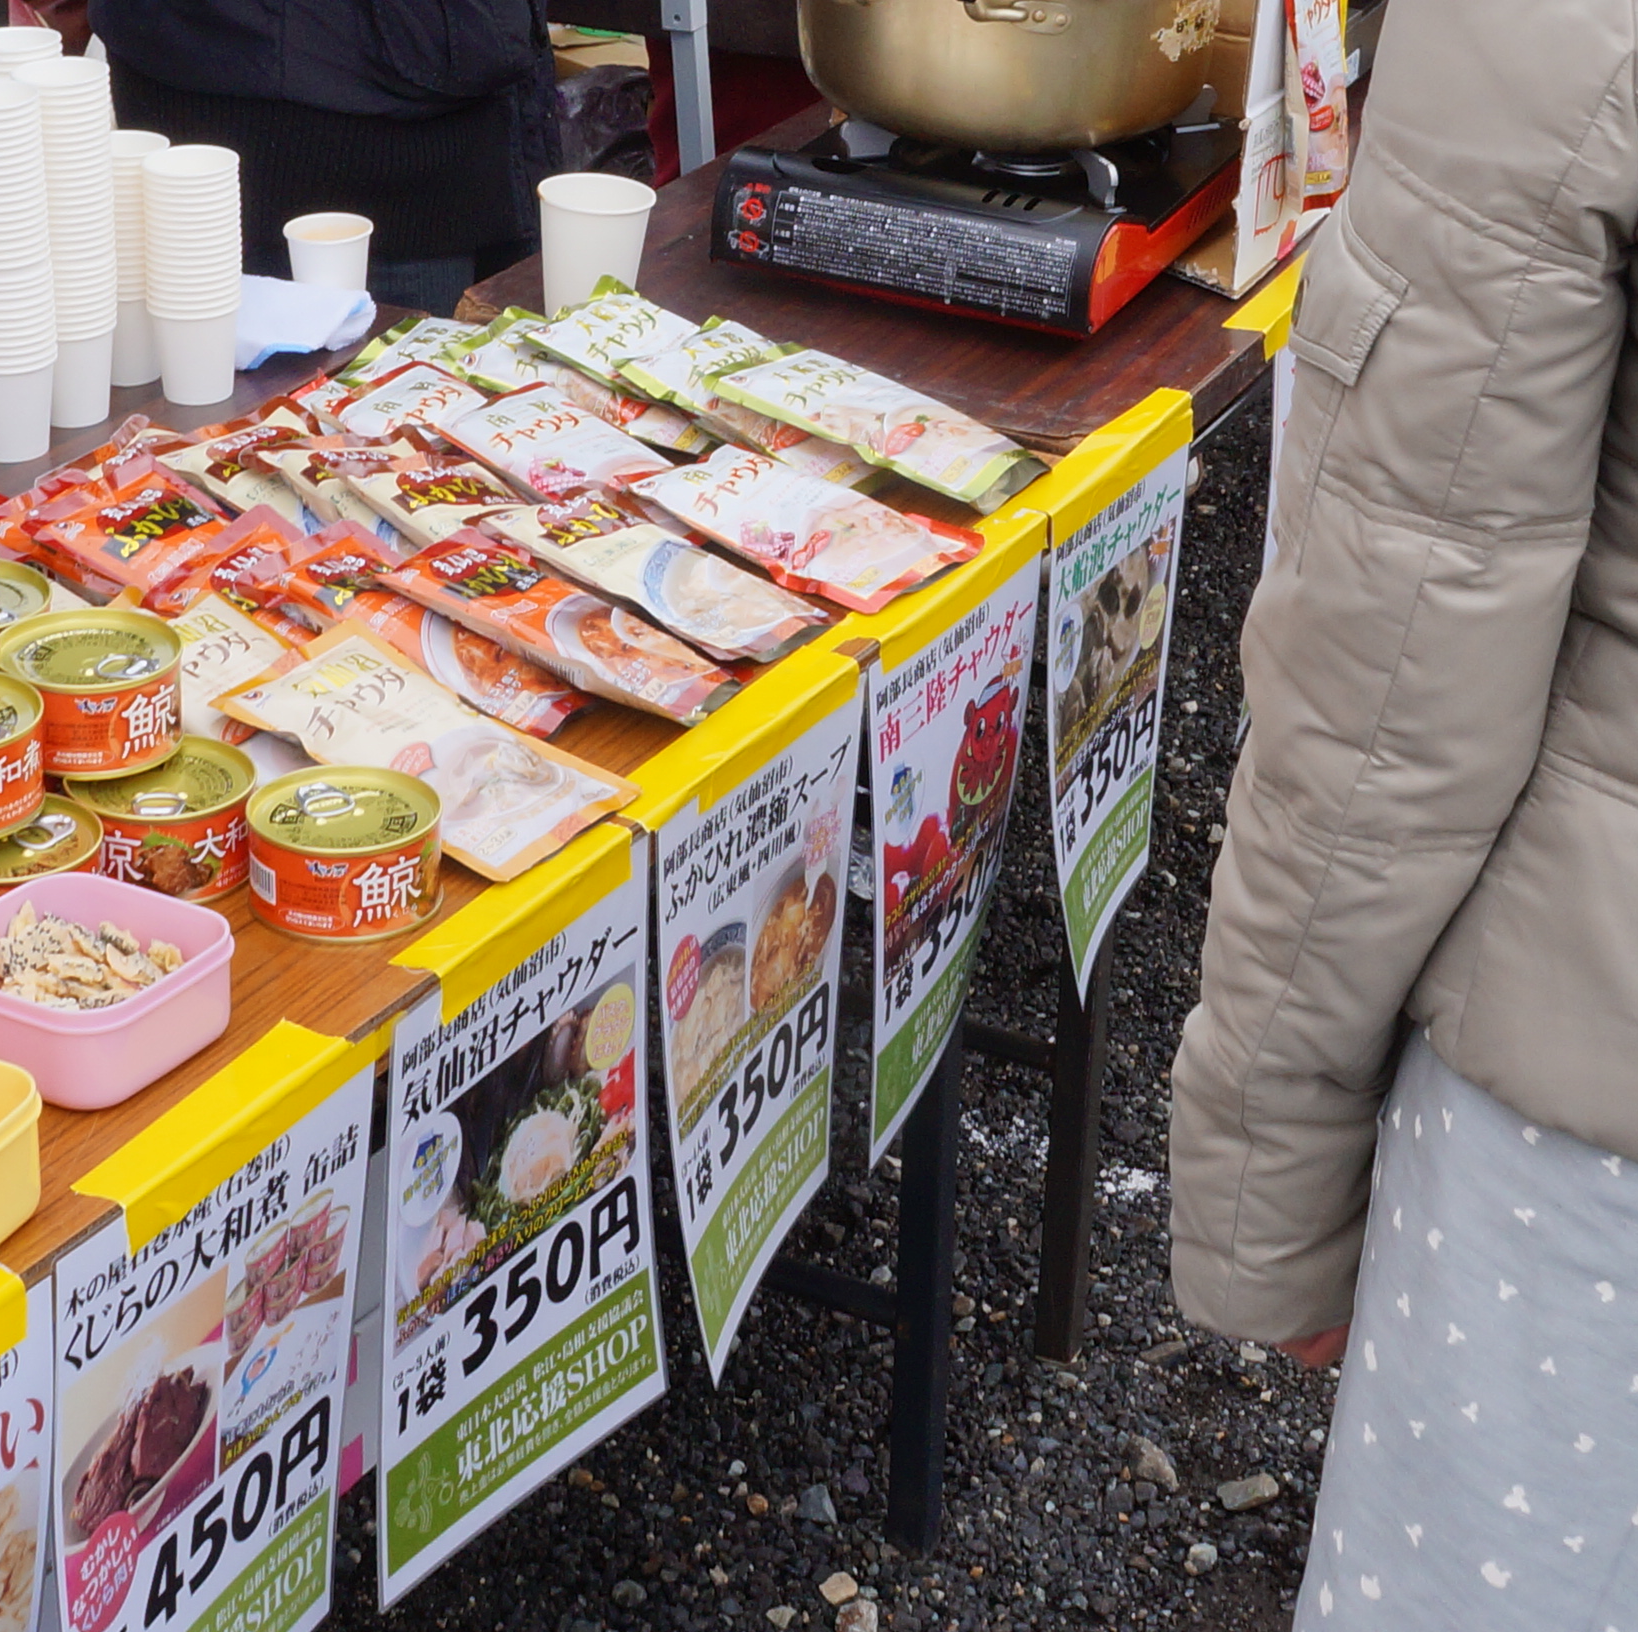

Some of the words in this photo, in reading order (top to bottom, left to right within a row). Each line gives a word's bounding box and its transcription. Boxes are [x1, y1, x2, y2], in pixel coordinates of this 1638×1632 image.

[1054, 483, 1181, 612] 大船渡チャウダー
[121, 682, 178, 760] 鯨
[877, 600, 1034, 765] 南三陸チャウダー
[1080, 687, 1157, 828] 350円
[351, 854, 423, 928] 鯨
[665, 734, 852, 925] ふかひれ濃縮スープ
[401, 925, 639, 1137] 気仙沼チャウダー
[884, 958, 914, 1028] 1袋
[718, 981, 830, 1170] 350円
[63, 1169, 292, 1371] くじらの大和煮
[302, 1122, 361, 1196] 缶詰
[685, 1148, 713, 1224] 1袋
[725, 1105, 826, 1267] 東北応援SHOP
[461, 1175, 641, 1379] 350円
[397, 1356, 447, 1437] 1袋
[456, 1313, 648, 1488] 東北応援SHOP
[72, 1526, 138, 1621] なつかしい
[80, 1524, 121, 1582] むかし
[143, 1393, 333, 1631] 450円
